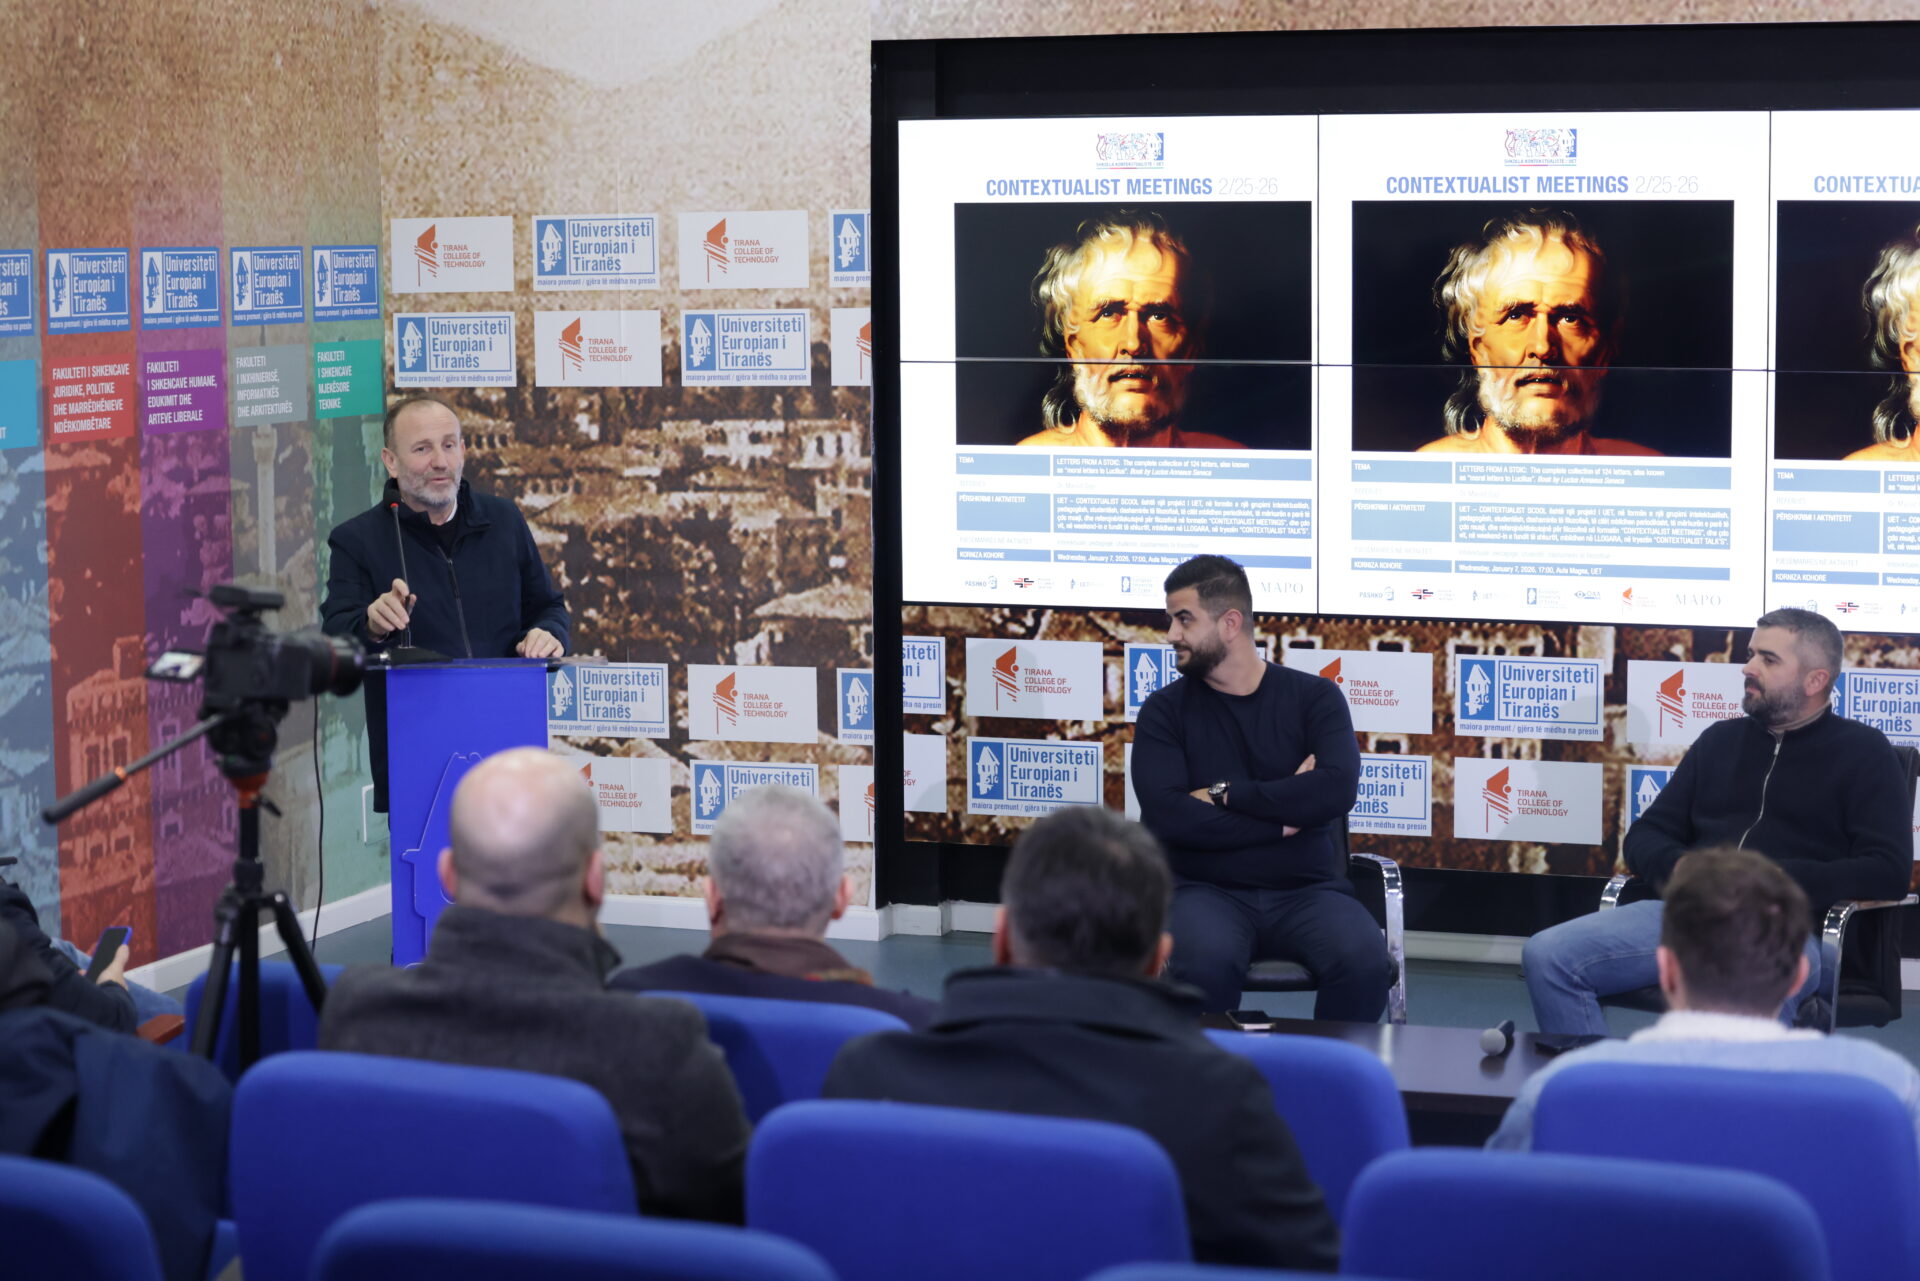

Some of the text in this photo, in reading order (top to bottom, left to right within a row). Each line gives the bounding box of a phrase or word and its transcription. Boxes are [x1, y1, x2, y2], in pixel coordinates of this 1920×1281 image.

[986, 177, 1278, 196] CONTEXTUALIST MEETINGS 2/25-26
[1386, 175, 1699, 194] CONTEXTUALIST MEETINGS 2/25-26
[571, 222, 650, 237] Universiteti
[572, 240, 628, 257] Europian
[734, 247, 764, 255] COLLEGE
[73, 256, 125, 274] Universiteti
[166, 255, 215, 272] Universiteti
[254, 255, 299, 270] Universiteti
[333, 253, 374, 268] Universiteti
[443, 260, 486, 268] TECHNOLOGY
[573, 256, 621, 271] Tiranës
[73, 276, 110, 295] Europian
[166, 274, 202, 292] Europian
[255, 273, 287, 290] Europian
[334, 270, 364, 287] Europian
[167, 292, 198, 308] Tiranës
[255, 290, 284, 306] Tiranës
[334, 287, 360, 303] Tiranës
[74, 295, 107, 312] Tiranës
[431, 320, 507, 335] Universiteti
[721, 317, 801, 332] Universiteti
[432, 337, 485, 354] Europian
[722, 335, 779, 352] Europian
[236, 356, 266, 368] FAKULTETI
[317, 351, 345, 362] FAKULTETI
[433, 353, 480, 368] Tiranës
[723, 352, 772, 367] Tiranës
[53, 366, 87, 379] FAKULTETI
[92, 363, 130, 377] SHKENCAVE
[147, 360, 179, 373] FAKULTETI
[86, 382, 115, 396] POLITIKE
[151, 377, 188, 390] SHKENCAVE
[189, 375, 217, 389] HUMANE,
[148, 393, 192, 408] EDUKIMIT DHE
[54, 404, 67, 416] DHE
[148, 409, 203, 425] ARTEVE LIBERALE
[238, 406, 250, 417] DHE
[959, 456, 974, 464] TEMA
[1355, 463, 1371, 471] TEMA
[1459, 465, 1485, 473] LETTERS
[583, 670, 660, 686] Universiteti
[1024, 668, 1052, 676] TIRANA
[1502, 665, 1594, 684] Universiteti
[1024, 677, 1055, 685] COLLEGE
[1349, 680, 1379, 688] TIRANA
[583, 687, 637, 704] Europian
[1025, 686, 1072, 694] TECHNOLOGY
[1349, 689, 1382, 697] COLLEGE
[1503, 683, 1567, 703] Europian
[1692, 692, 1723, 700] TIRANA
[1349, 698, 1400, 707] TECHNOLOGY
[1692, 701, 1739, 711] COLLEGE OF
[1853, 696, 1920, 716] Europian
[583, 704, 632, 719] Tiranës
[743, 710, 788, 718] TECHNOLOGY
[1503, 702, 1559, 719] Tiranës
[1692, 711, 1745, 719] TECHNOLOGY
[1460, 723, 1482, 731] maiora
[1484, 724, 1511, 733] premunt
[1578, 727, 1598, 737] presin
[1010, 747, 1094, 765] Universiteti
[731, 770, 810, 786] Universiteti
[1010, 765, 1070, 783] Europian
[1359, 763, 1422, 780] versiteti
[600, 791, 628, 799] COLLEGE
[1011, 782, 1063, 799] Tiranës
[1357, 780, 1396, 798] opian
[1517, 789, 1548, 798] TIRANA
[600, 800, 643, 808] TECHNOLOGY
[1354, 799, 1389, 814] anës
[1517, 798, 1563, 807] COLLEGE OF
[1517, 807, 1569, 817] TECHNOLOGY
